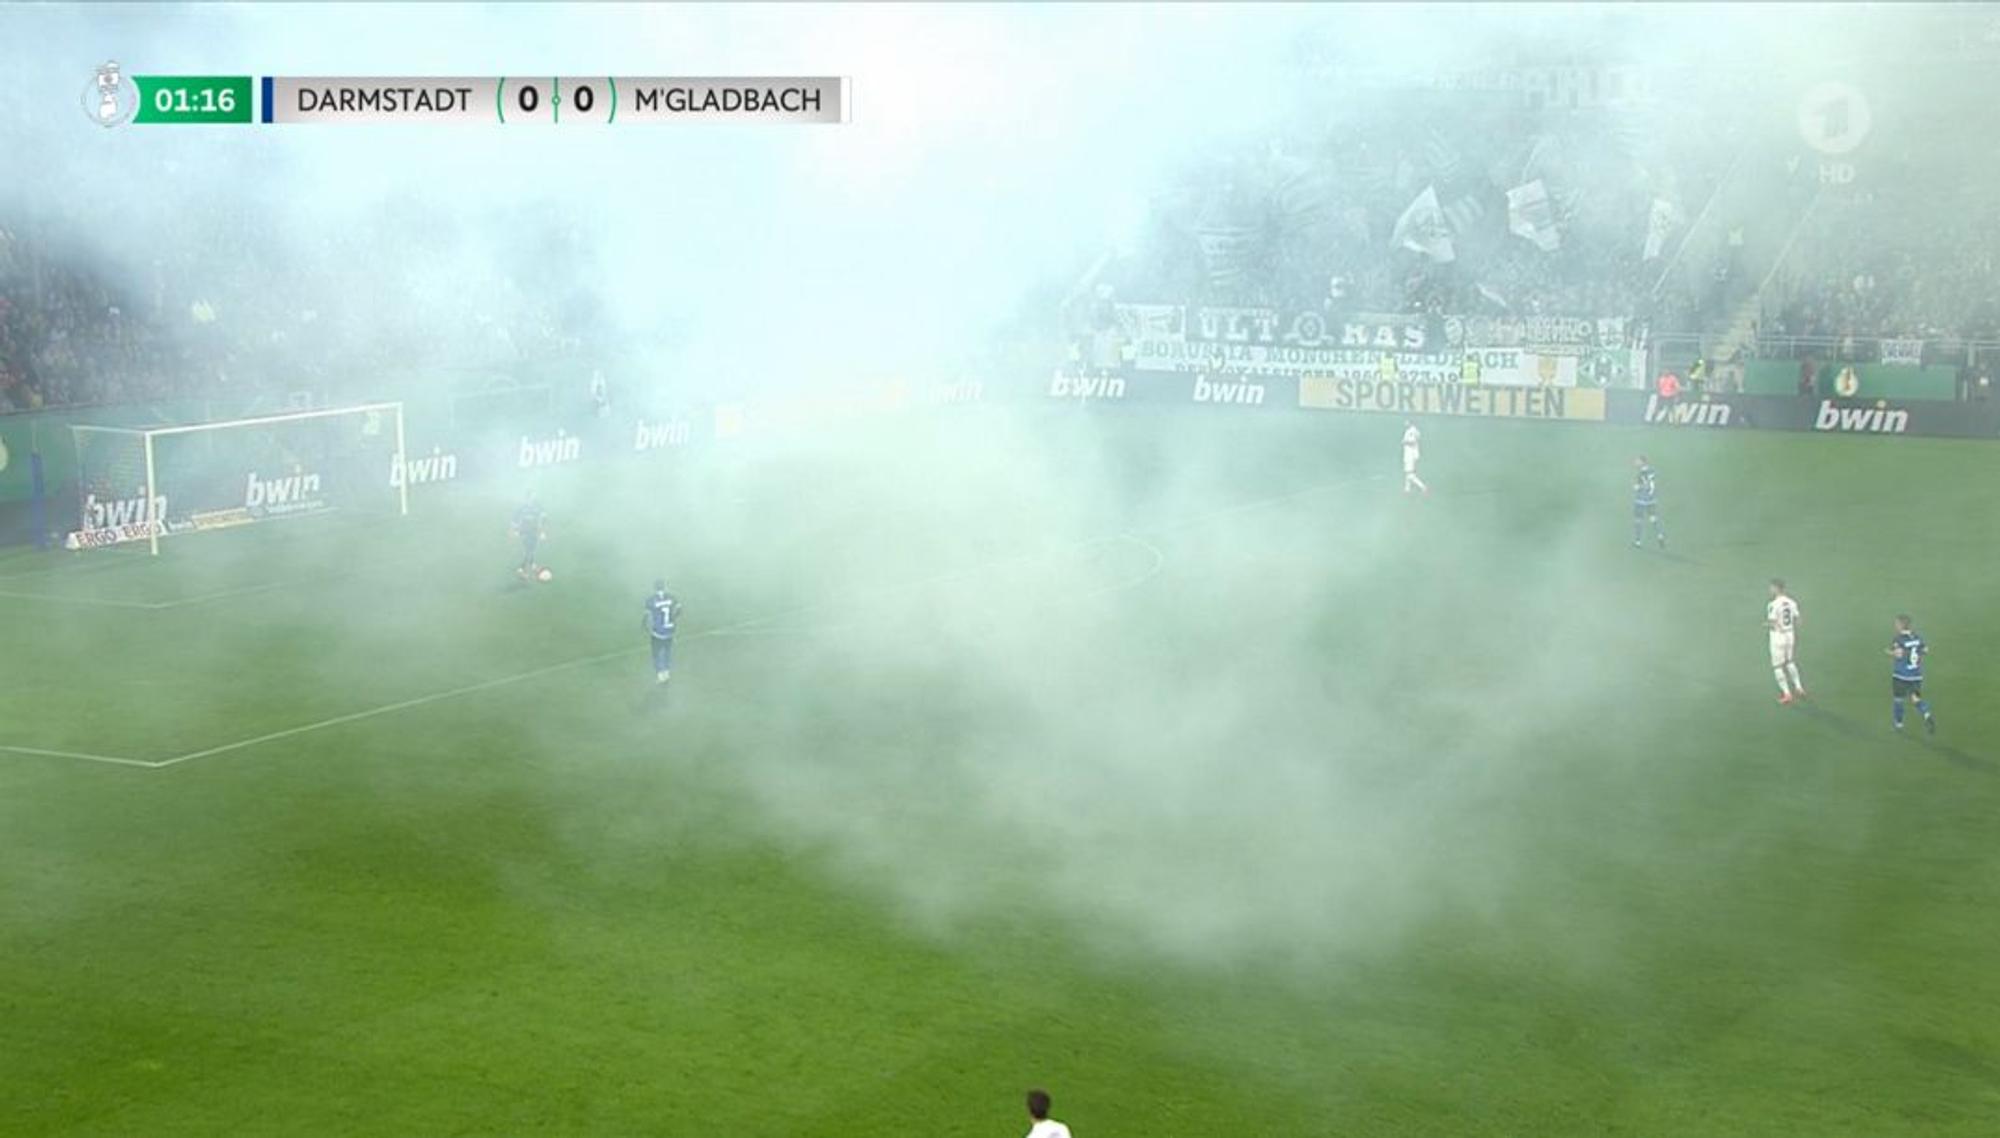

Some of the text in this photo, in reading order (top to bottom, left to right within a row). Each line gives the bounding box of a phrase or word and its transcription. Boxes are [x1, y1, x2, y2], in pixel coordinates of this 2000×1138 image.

[1049, 367, 1126, 398] bwin
[1193, 375, 1265, 405] bwin
[1335, 379, 1566, 419] SPORTWETTEN
[634, 418, 690, 451] bwin
[1815, 399, 1909, 434] bwin
[389, 446, 457, 488] bwin
[517, 428, 581, 468] bwin
[245, 464, 321, 507] bwin
[83, 485, 168, 530] bwin
